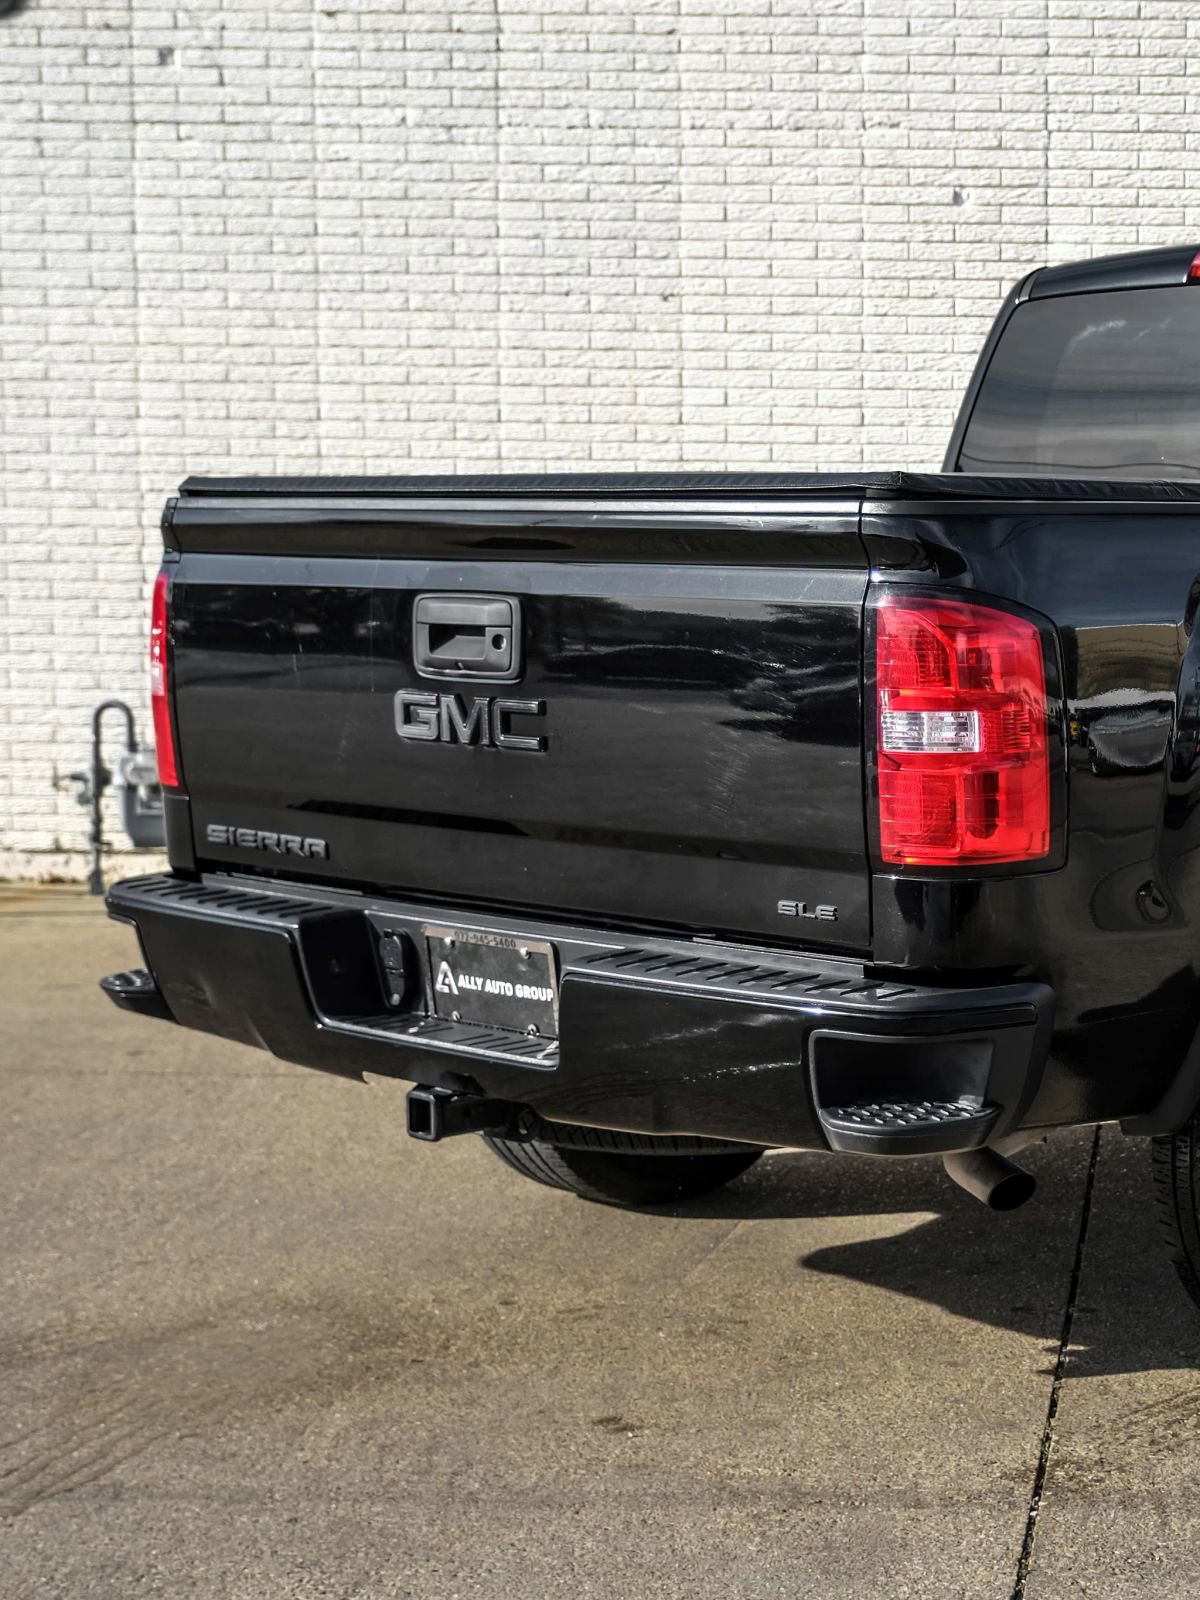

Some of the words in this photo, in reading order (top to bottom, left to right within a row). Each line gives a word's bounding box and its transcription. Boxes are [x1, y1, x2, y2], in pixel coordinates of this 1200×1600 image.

[394, 688, 548, 752] GMC
[206, 823, 331, 860] SIERRA
[777, 899, 838, 921] SLE
[457, 973, 484, 992] ALLY
[484, 978, 514, 997] AUTO
[515, 983, 554, 1002] GROUP
